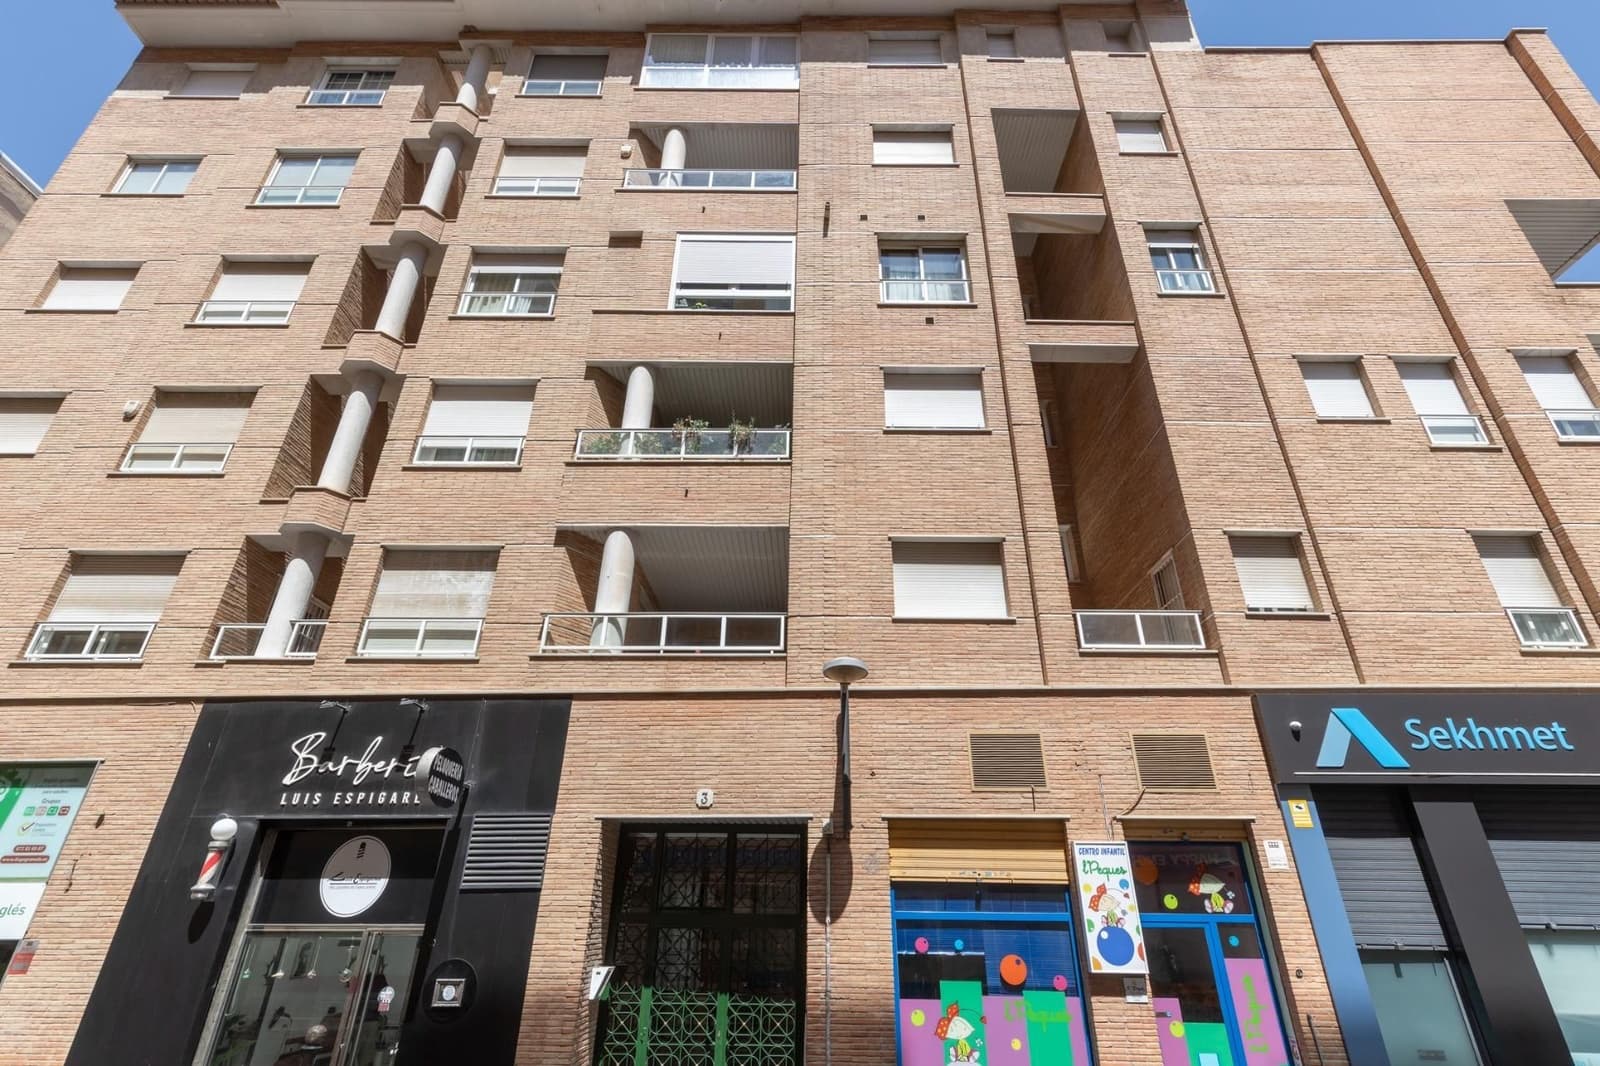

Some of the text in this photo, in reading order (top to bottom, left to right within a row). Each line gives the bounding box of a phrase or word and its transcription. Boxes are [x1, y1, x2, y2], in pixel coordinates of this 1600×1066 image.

[1404, 718, 1575, 750] Sekhmet
[282, 732, 420, 785] Barberí
[280, 792, 421, 805] LUIS ESPIGAR
[701, 792, 708, 805] 3
[1079, 847, 1126, 856] CENTRO INFANTIL
